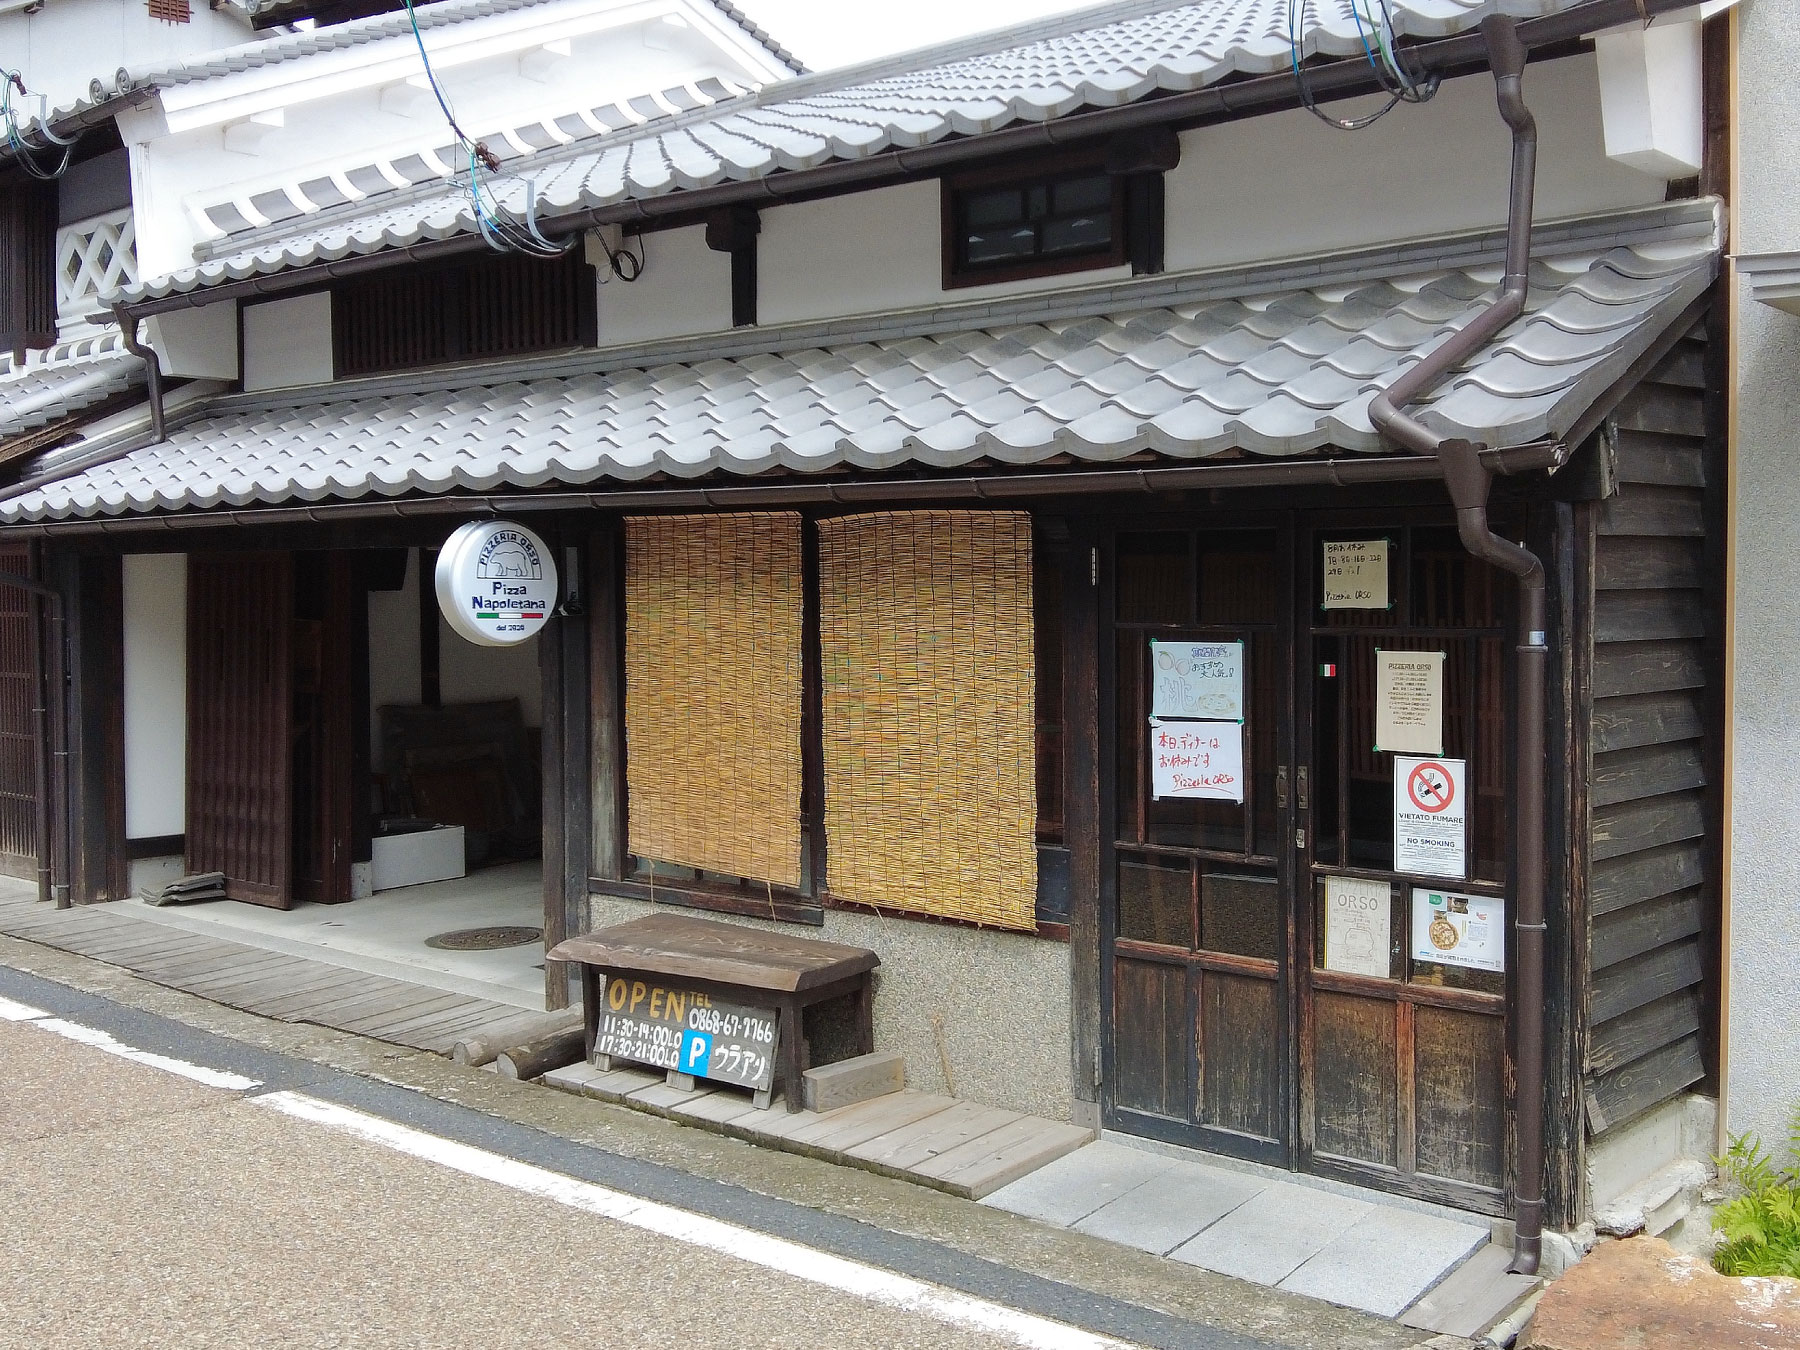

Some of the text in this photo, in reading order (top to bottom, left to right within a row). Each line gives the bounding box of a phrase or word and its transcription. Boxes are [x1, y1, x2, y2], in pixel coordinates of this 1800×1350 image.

[480, 533, 540, 566] PIZZERIA ORSO
[492, 581, 527, 595] Pizza
[472, 596, 546, 611] Napoletana
[1398, 812, 1464, 824] VIETATO FUMARE
[1407, 837, 1456, 848] NO SMOKING
[1337, 894, 1378, 911] ORSO
[609, 978, 685, 1023] OPEN
[690, 991, 712, 1008] TEL
[689, 1037, 706, 1068] P
